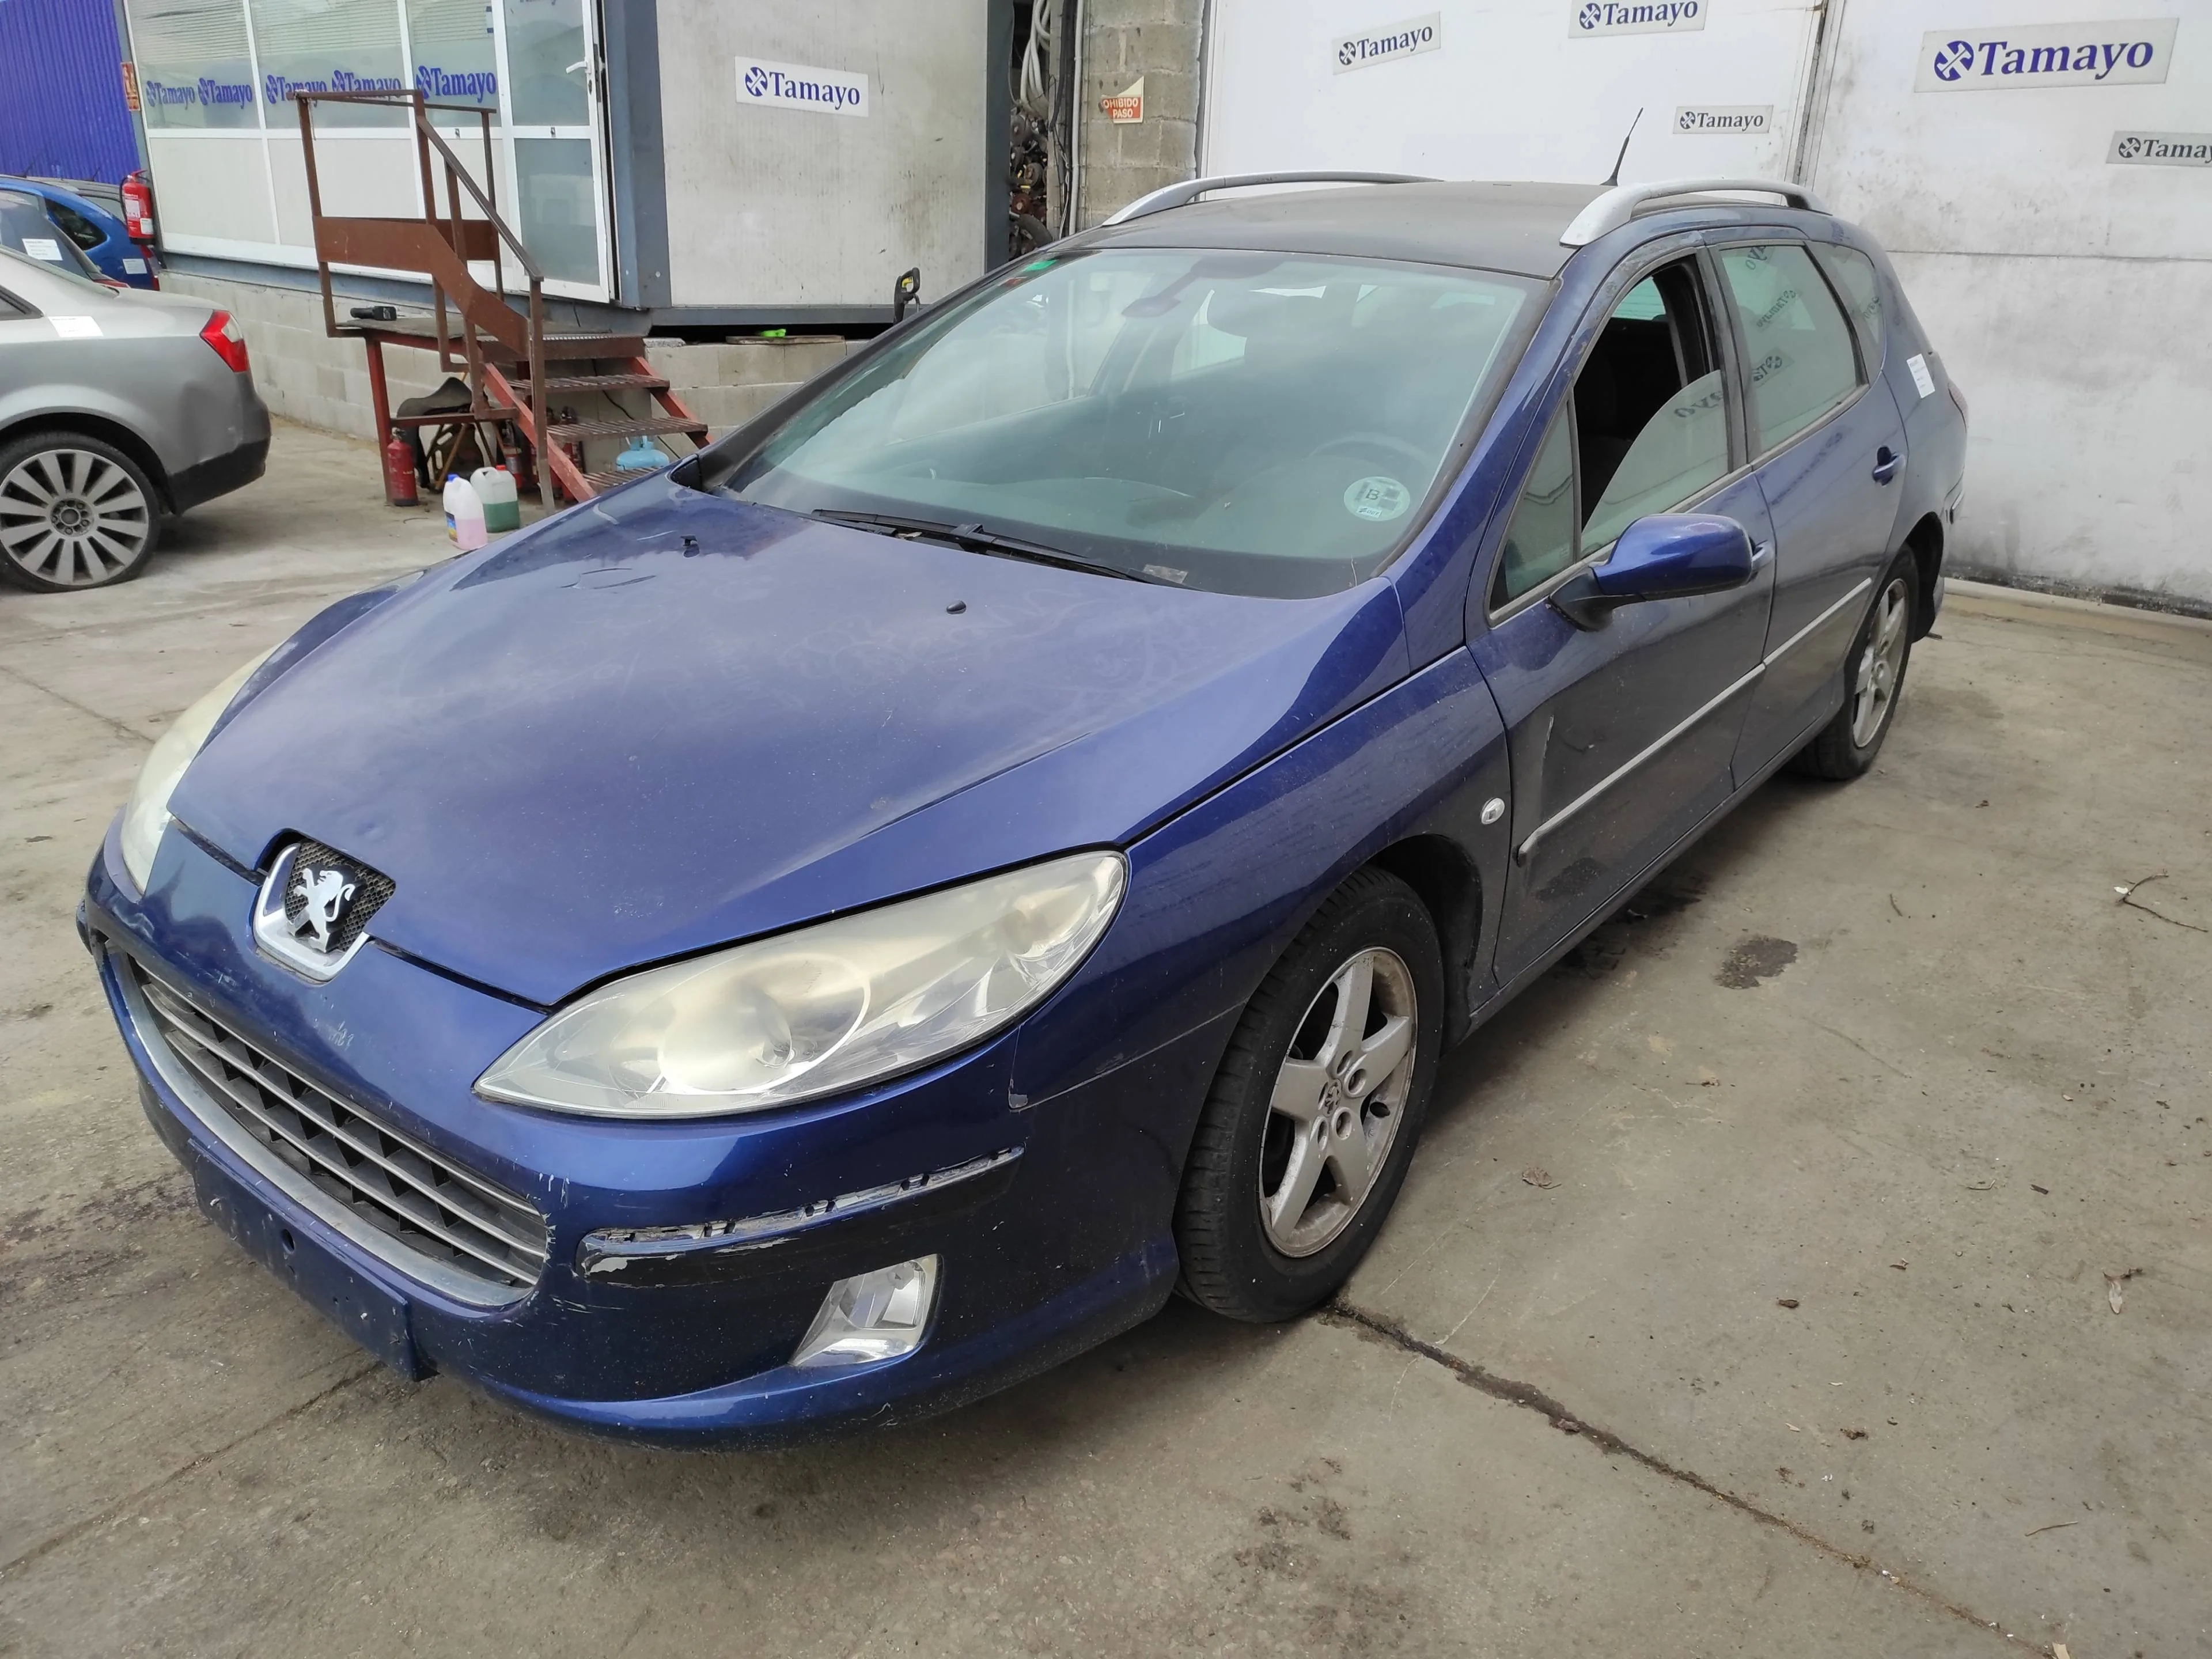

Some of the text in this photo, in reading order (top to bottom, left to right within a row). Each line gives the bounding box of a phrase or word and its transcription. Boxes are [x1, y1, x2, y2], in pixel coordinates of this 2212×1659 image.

[1603, 1, 1698, 26] Tamayo
[1357, 26, 1433, 60] Tamayo
[1978, 41, 2153, 79] Tamayo
[154, 82, 195, 110] Tamayo
[207, 79, 253, 109] Tamayo
[430, 67, 497, 103] Tamayo
[769, 71, 860, 110] Tamayo
[1103, 98, 1138, 109] OHIBIDO
[1112, 108, 1133, 119] PASO
[1697, 113, 1763, 131] Tamayo
[1365, 488, 1380, 500] B
